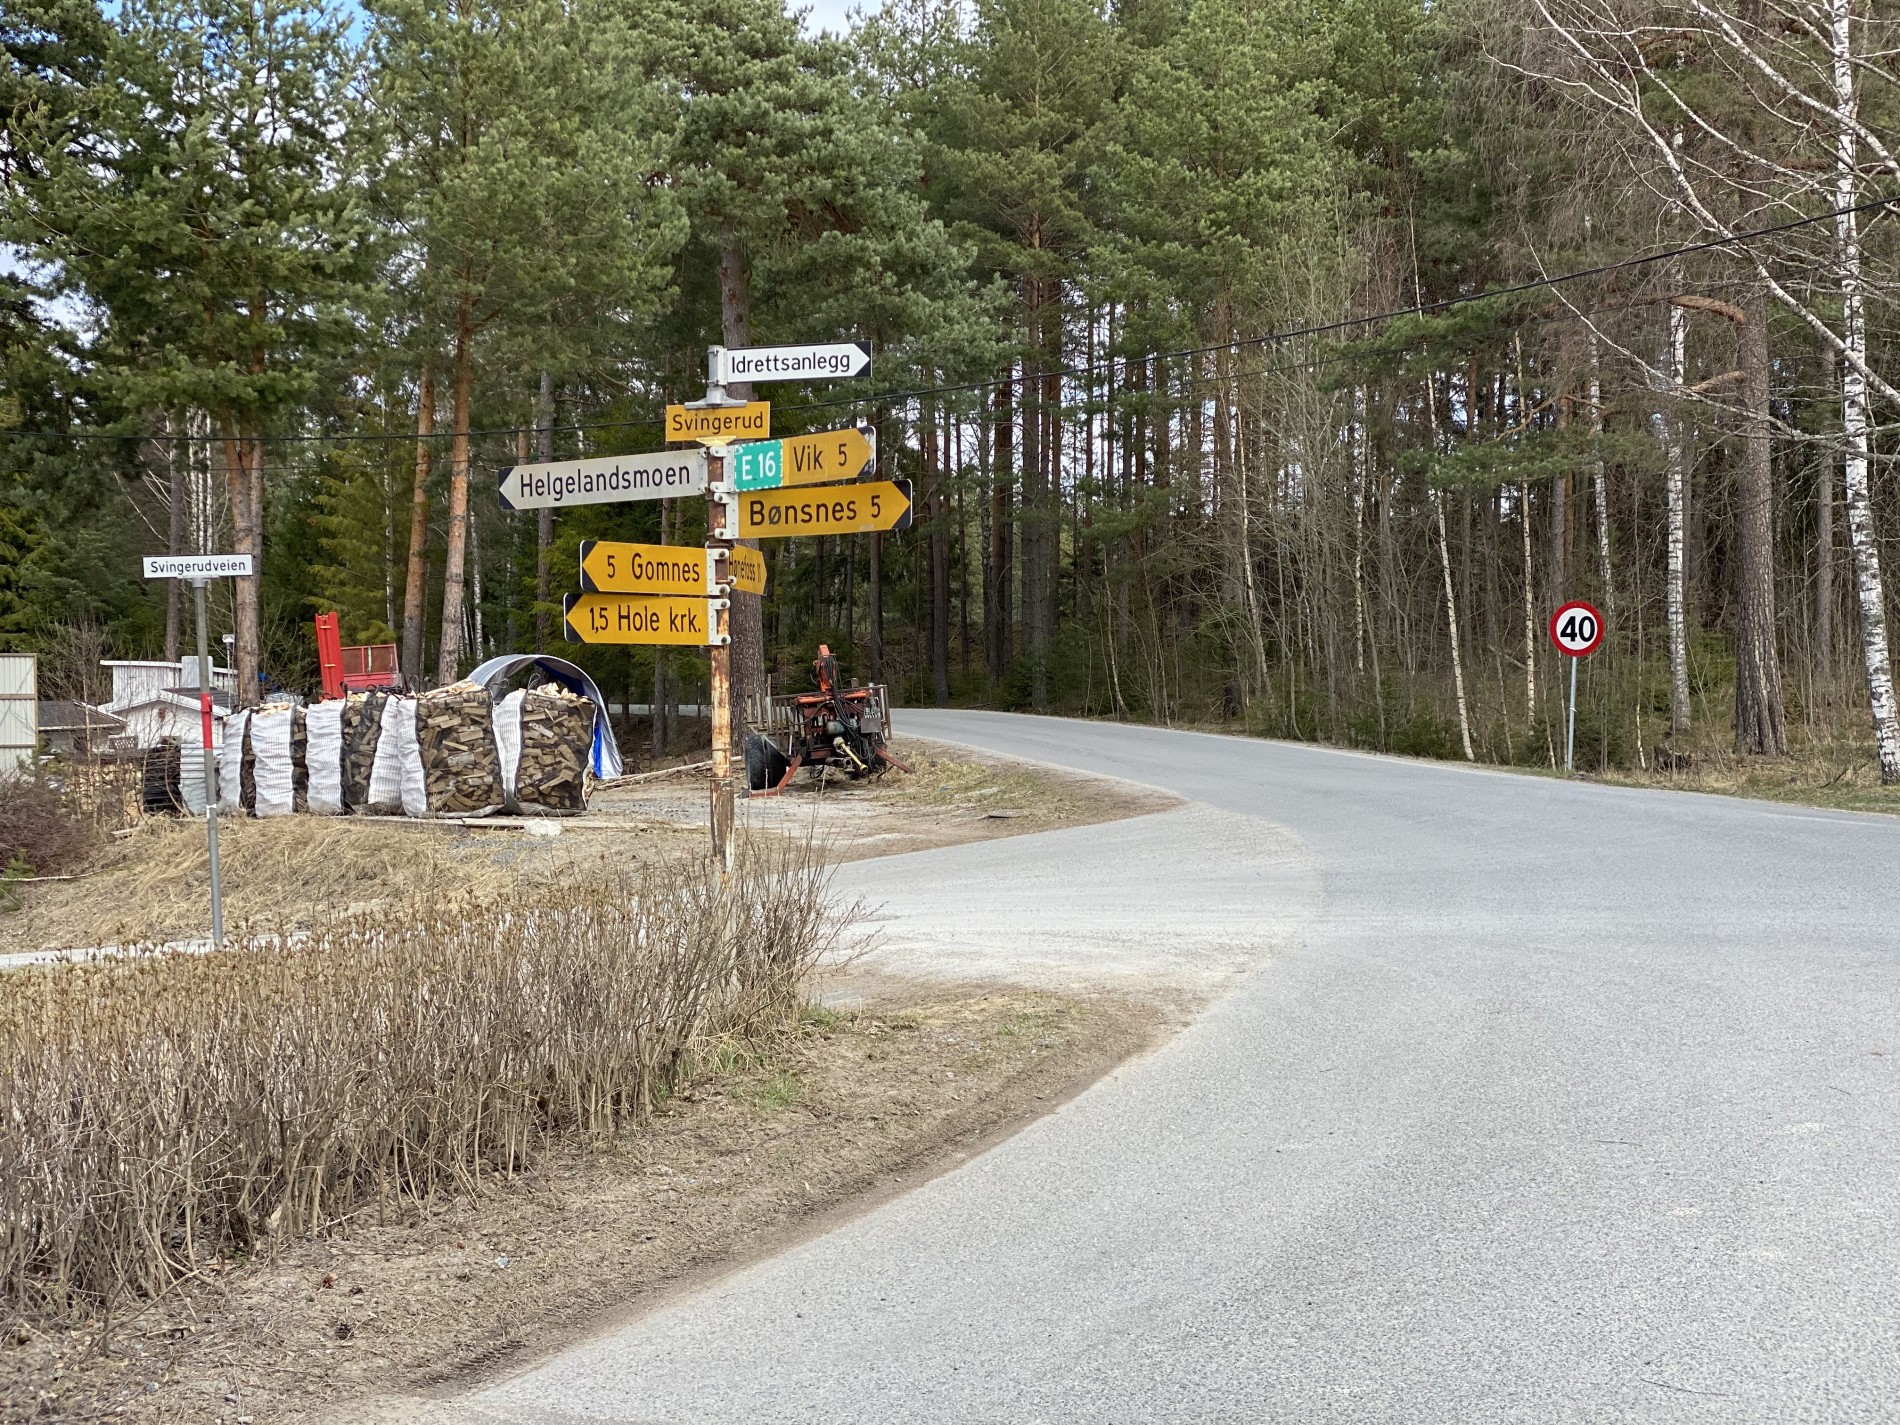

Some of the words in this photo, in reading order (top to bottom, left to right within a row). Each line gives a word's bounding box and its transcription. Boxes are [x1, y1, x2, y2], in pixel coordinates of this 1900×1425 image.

[731, 352, 851, 373] Idrettsanlegg
[672, 411, 763, 435] Svingerud
[742, 455, 752, 481] E
[758, 451, 776, 478] 16
[793, 444, 824, 472] Vik
[838, 443, 848, 467] 5
[520, 465, 690, 501] Helgelandsmoen
[750, 500, 857, 527] Bønsnes
[870, 494, 881, 519] 5
[150, 560, 246, 576] Svingerudveien
[607, 554, 616, 579] 5
[631, 552, 700, 582] Gomnes
[589, 606, 609, 634] 1,5
[618, 604, 660, 632] Hole
[669, 606, 701, 633] krk.
[1560, 615, 1596, 642] 40
